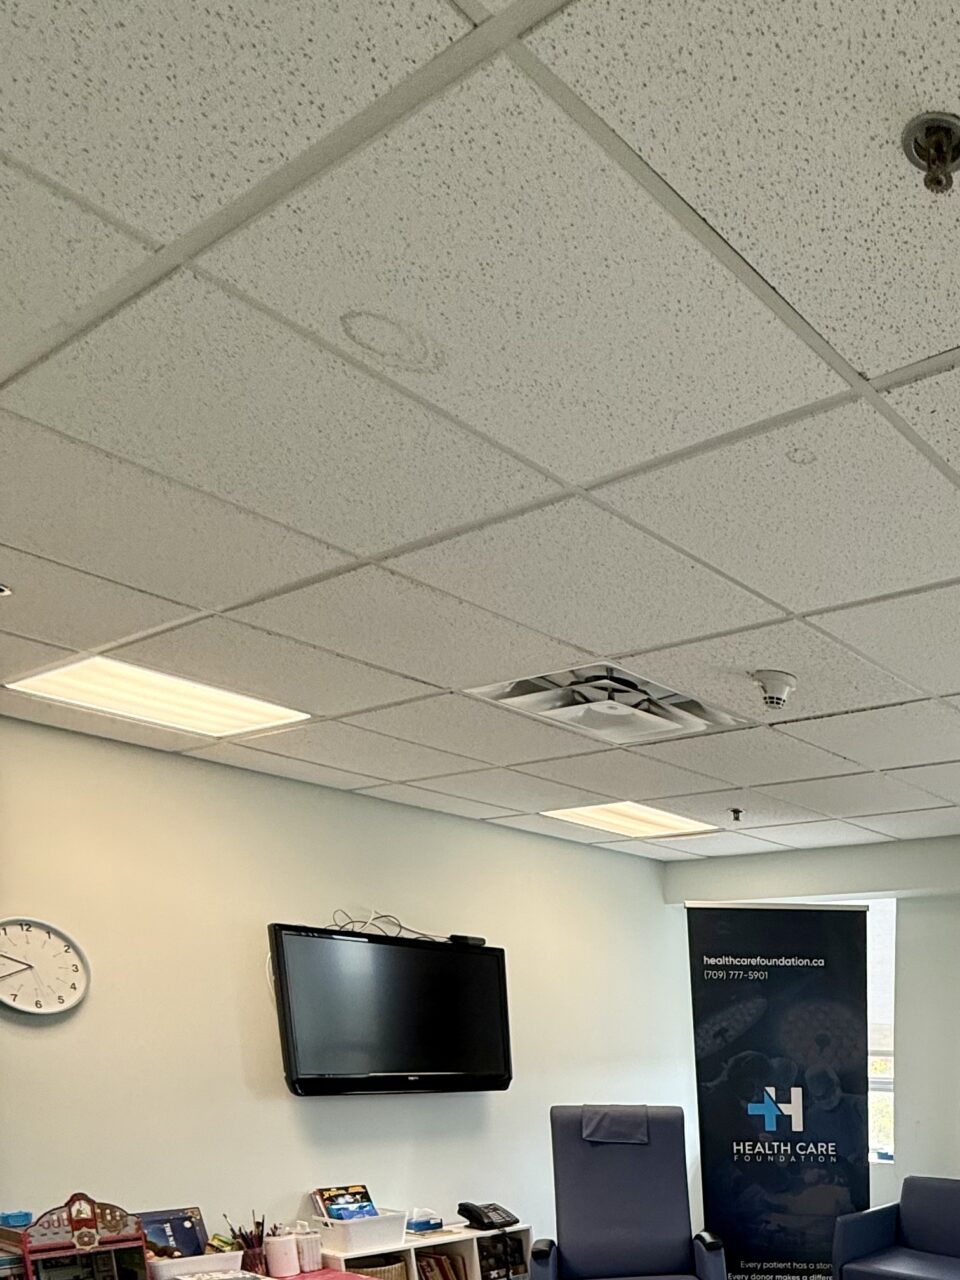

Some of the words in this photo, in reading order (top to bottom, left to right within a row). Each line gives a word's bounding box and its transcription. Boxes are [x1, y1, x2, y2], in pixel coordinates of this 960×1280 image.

[18, 923, 32, 932] 12
[45, 930, 52, 940] 1
[63, 944, 71, 953] 2
[703, 956, 825, 967] healthcarefoundation.ca
[71, 964, 79, 973] 3
[704, 970, 726, 980] (709)
[729, 971, 768, 980] 777-5901
[70, 982, 77, 991] 4
[10, 993, 18, 1002] 7
[57, 995, 65, 1004] 5
[34, 999, 43, 1009] 6
[733, 1142, 791, 1154] HEALTH
[796, 1142, 836, 1155] CARE
[740, 1261, 761, 1270] Every
[763, 1261, 791, 1270] patient
[793, 1262, 807, 1270] has
[750, 1273, 773, 1280] donor
[775, 1273, 800, 1280] makes
